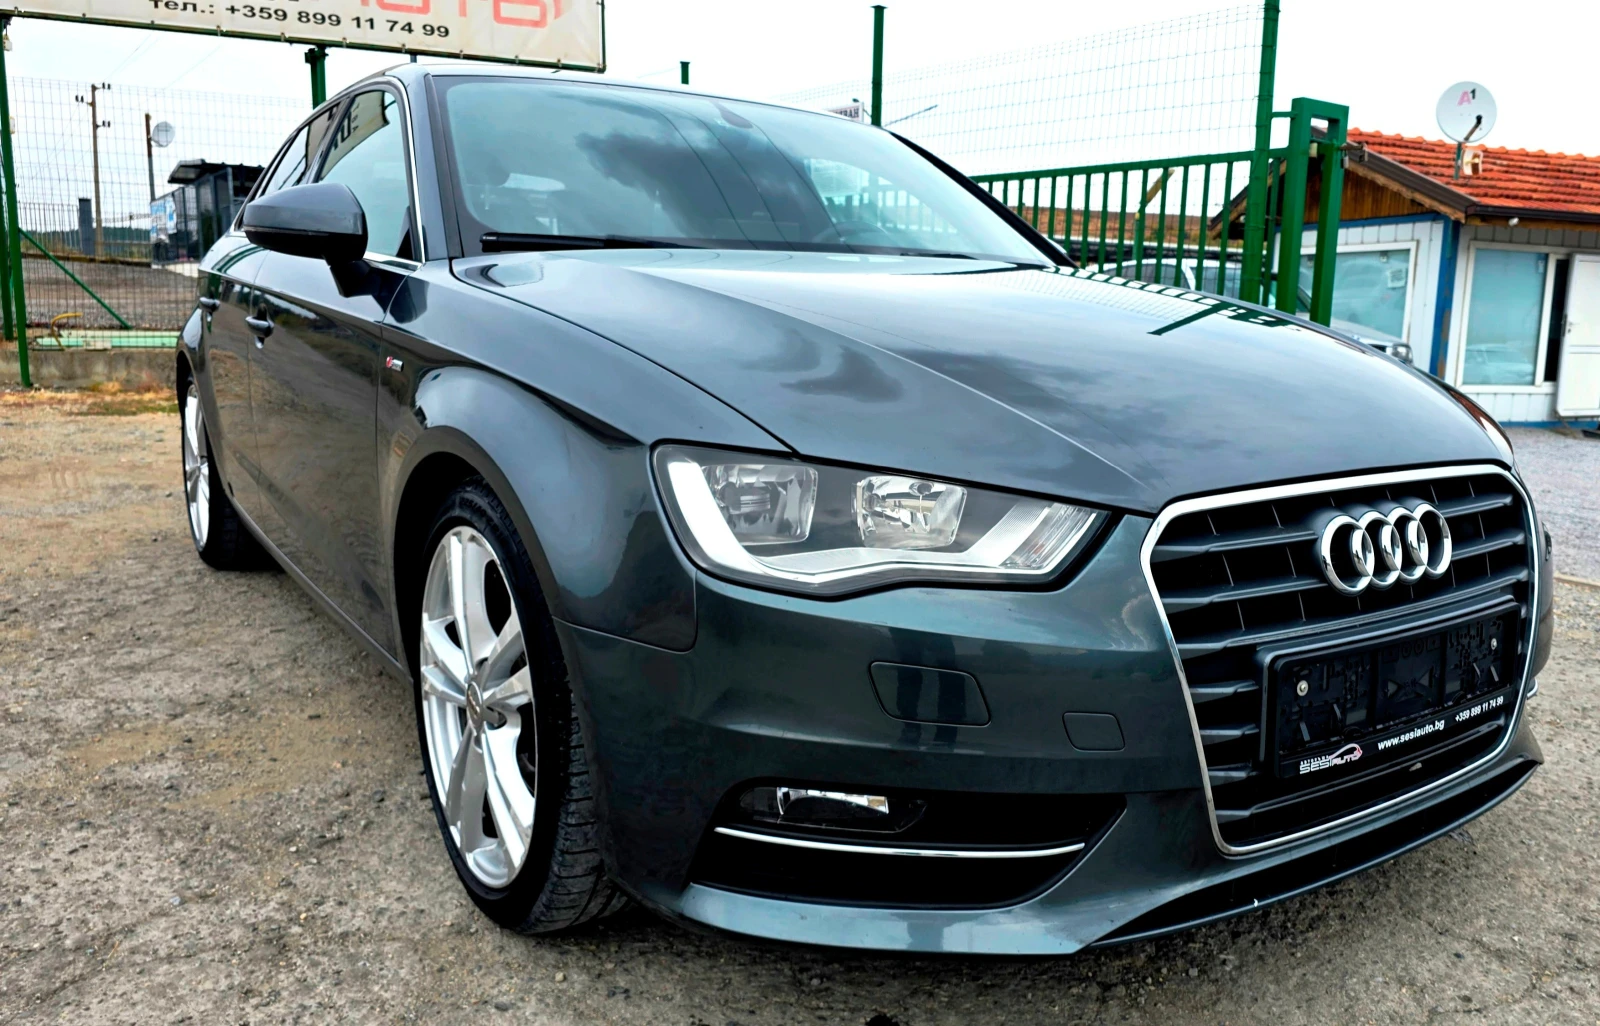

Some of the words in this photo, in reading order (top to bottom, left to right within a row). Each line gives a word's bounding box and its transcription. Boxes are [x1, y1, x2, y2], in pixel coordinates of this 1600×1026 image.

[225, 5, 288, 21] +359
[297, 11, 341, 26] 899
[351, 16, 375, 30] 11
[386, 19, 414, 34] 74
[422, 24, 449, 38] 99
[1457, 88, 1476, 106] A1
[1455, 709, 1470, 722] +359
[1470, 705, 1481, 717] 899
[1482, 701, 1488, 712] 11
[1489, 698, 1496, 710] 74
[1497, 695, 1504, 706] 99
[1377, 720, 1445, 750] www.sesiauto.bg
